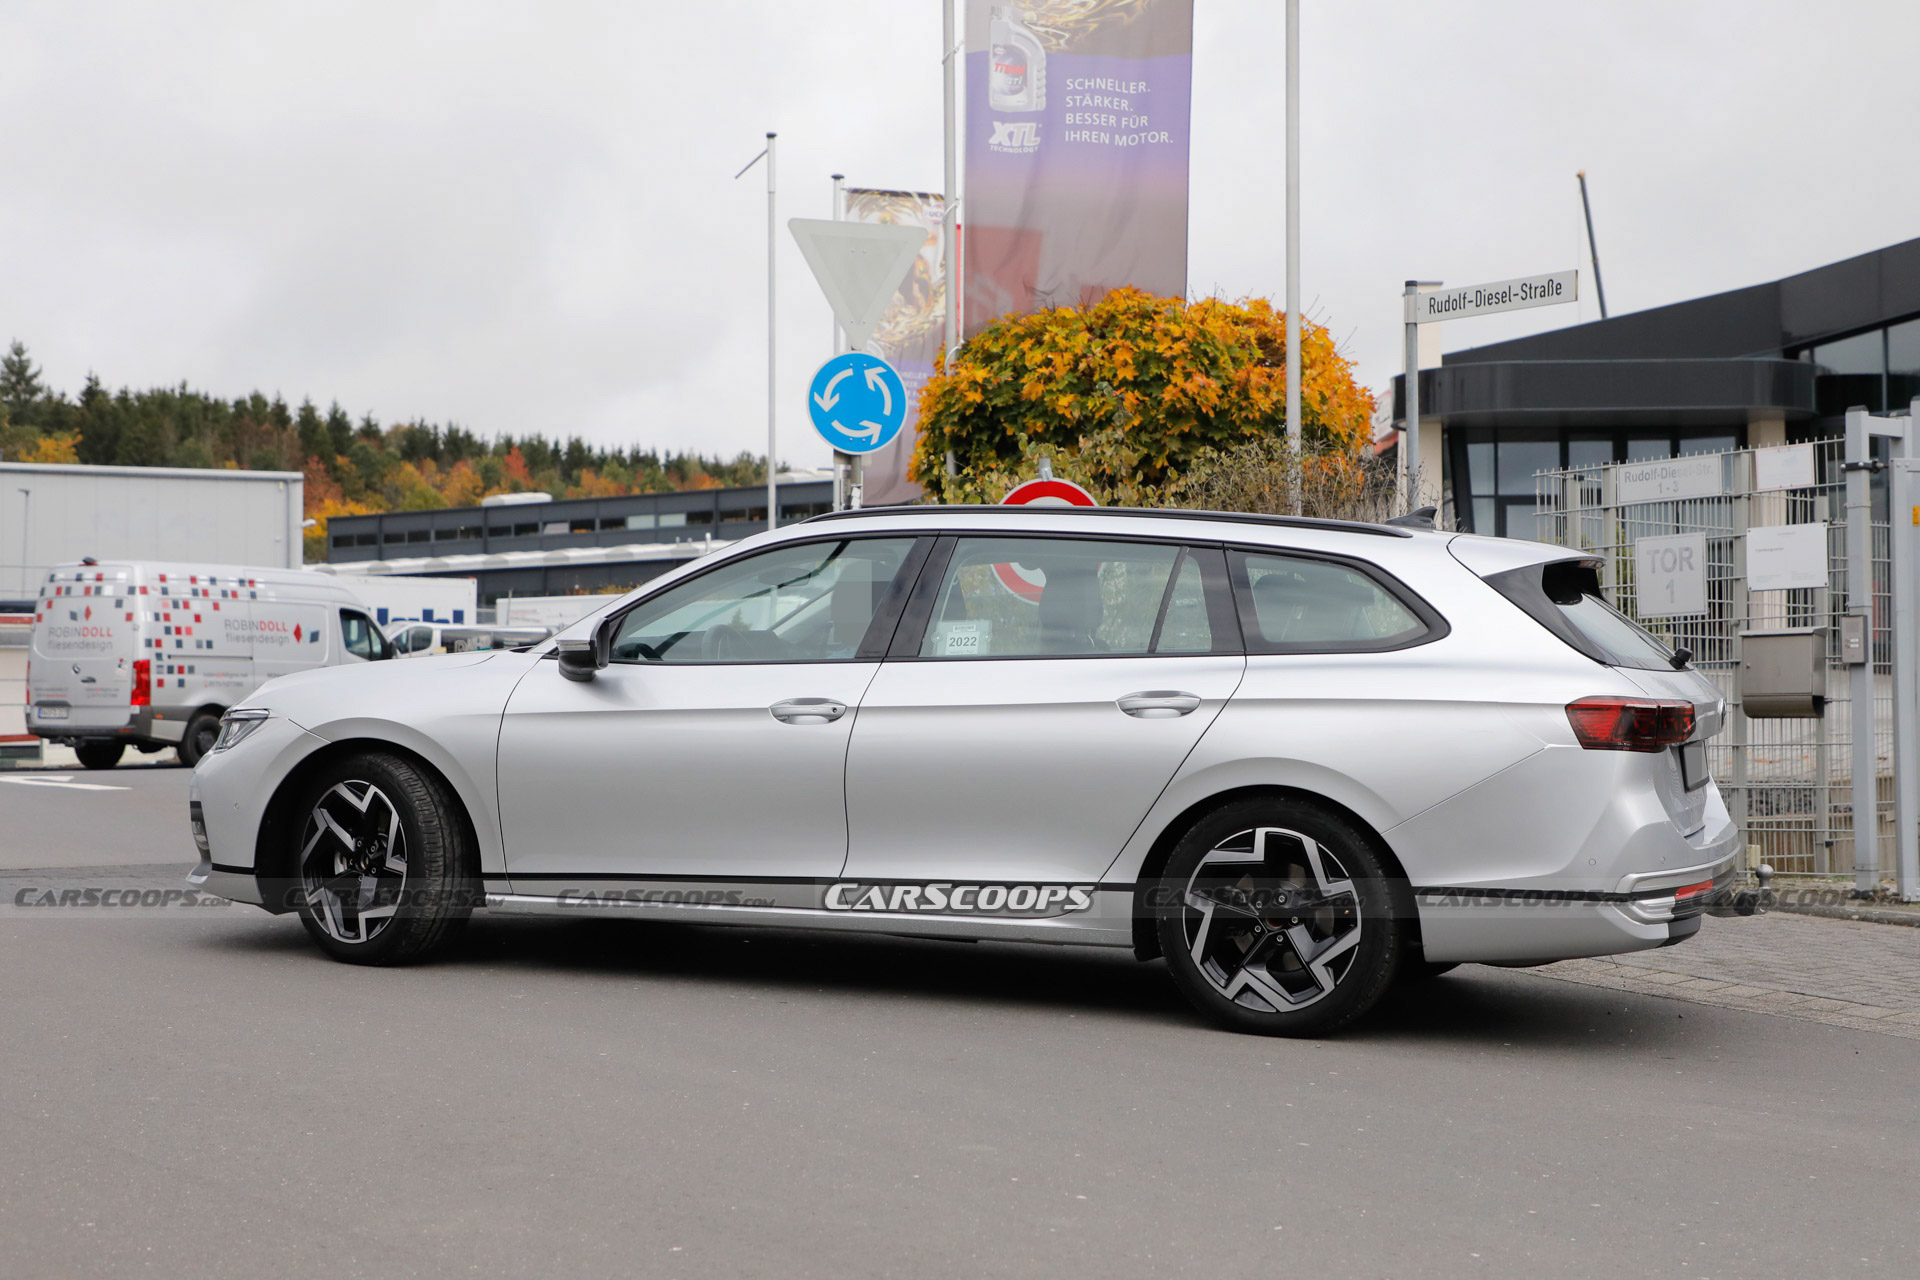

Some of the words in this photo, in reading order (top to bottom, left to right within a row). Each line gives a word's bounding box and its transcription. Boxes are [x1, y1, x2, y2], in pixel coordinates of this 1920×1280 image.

[1066, 77, 1151, 94] SCHNELLER.
[1065, 93, 1133, 112] STÄRKER.
[1065, 112, 1117, 128] BESSER
[1121, 114, 1149, 129] FÜR
[988, 120, 1041, 147] XTL
[1064, 130, 1110, 145] IHREN
[1114, 131, 1174, 147] MOTOR.
[990, 144, 1039, 154] TECHNOLOGY
[1428, 278, 1563, 315] Rudolf-Diesel-Straße
[1624, 463, 1714, 484] Rudolf-Diesel-Str.
[1657, 482, 1664, 494] 1
[1672, 480, 1680, 493] 3
[1646, 546, 1695, 574] TOR
[1665, 578, 1676, 604] 1
[47, 626, 113, 638] ROBINDOLL
[224, 619, 289, 632] ROBINDOLL
[48, 640, 113, 652] fliesendesign
[226, 632, 290, 647] fliesendesign
[948, 636, 978, 648] 2022
